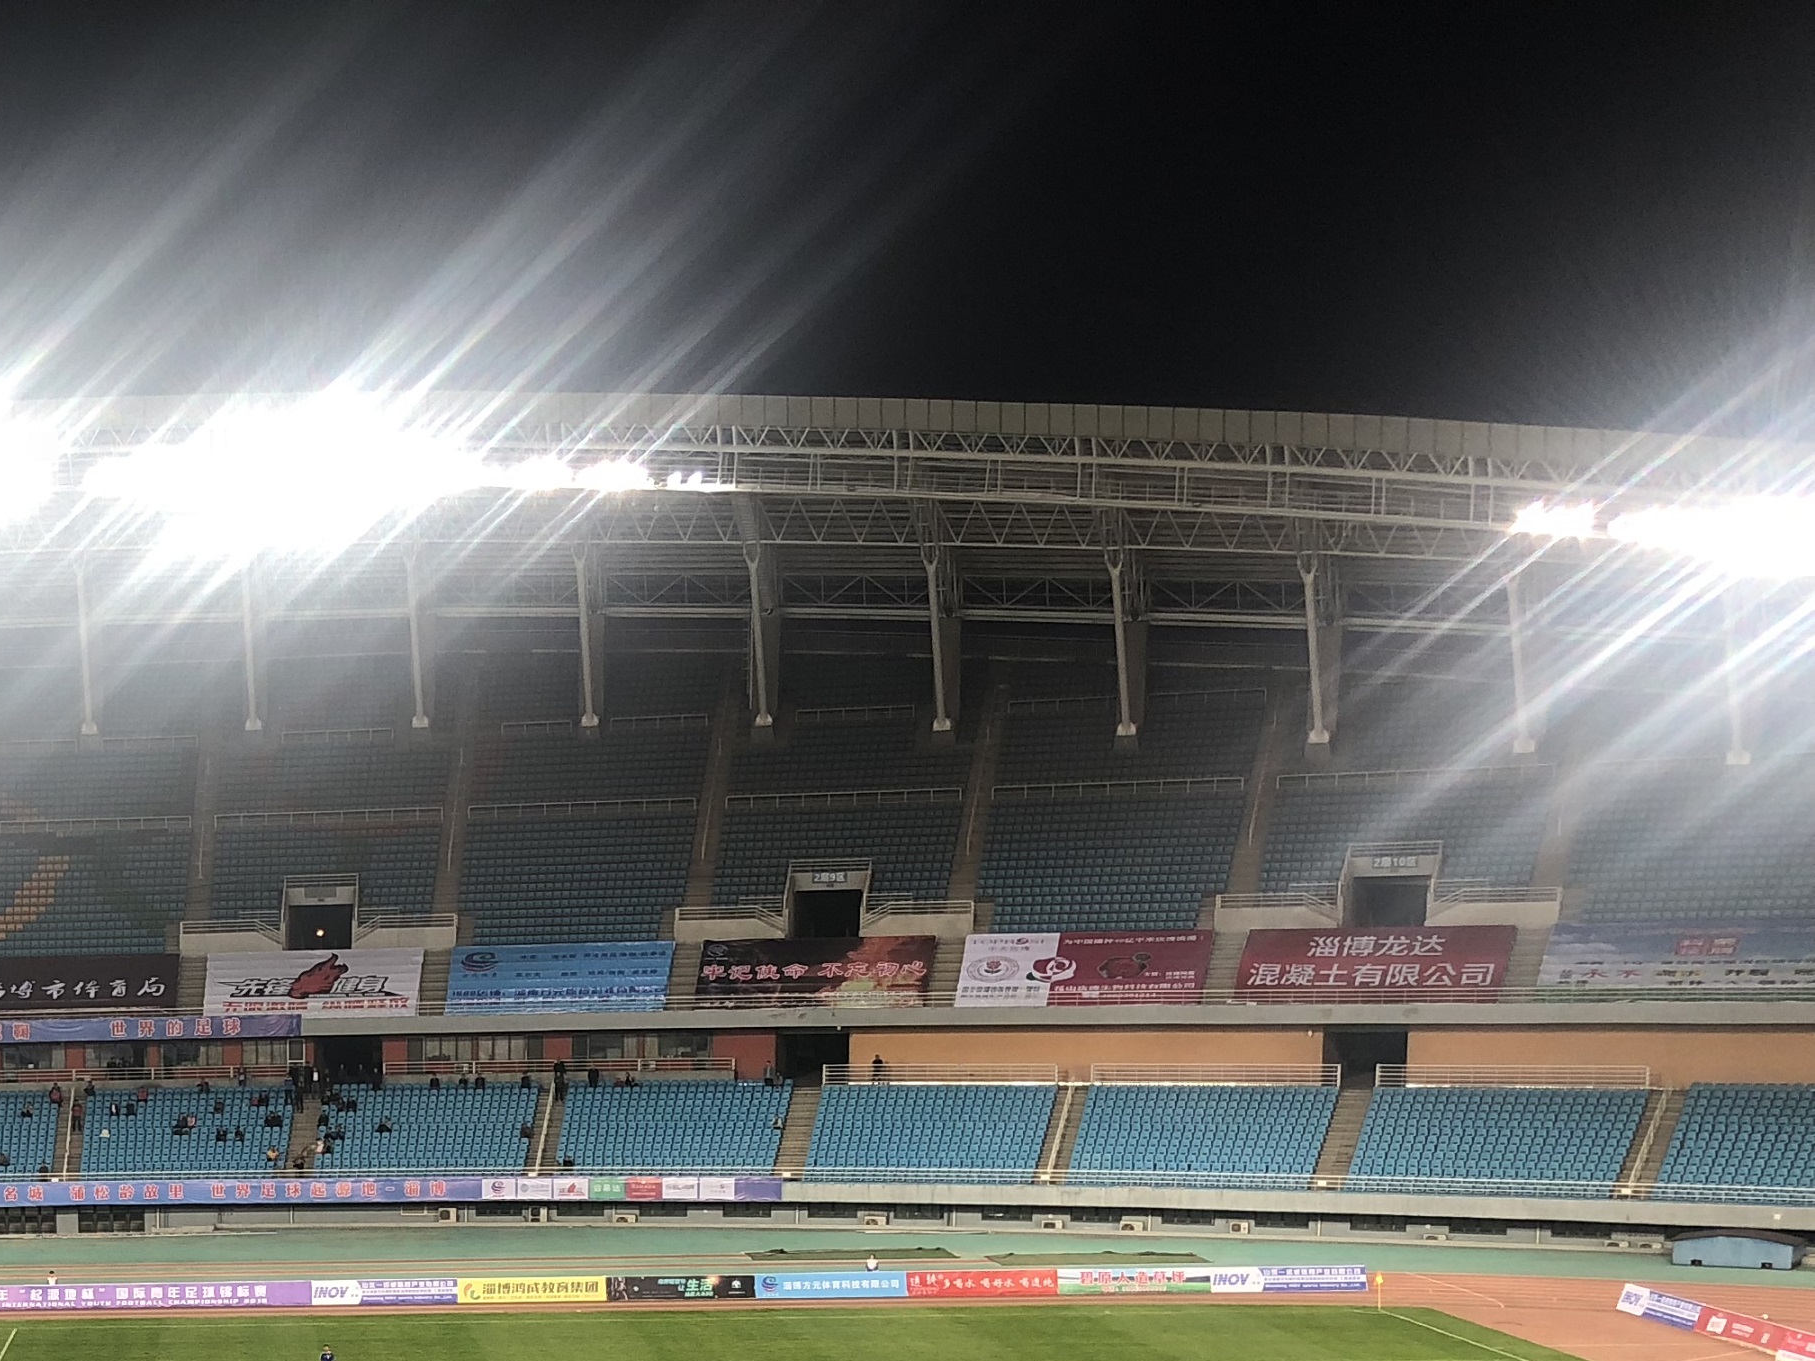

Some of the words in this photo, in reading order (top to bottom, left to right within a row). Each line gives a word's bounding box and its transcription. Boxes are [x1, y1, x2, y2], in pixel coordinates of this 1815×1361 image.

[1306, 934, 1447, 958] 淄博龙达
[701, 962, 809, 980] 牢记使命
[817, 960, 927, 978] 不忘初心
[1246, 962, 1496, 987] 混凝土有限公司
[109, 1018, 242, 1038] 世界的足球
[68, 1182, 185, 1200] 蒲松龄故里
[783, 1279, 900, 1291] 淄博方元体育科技有限公司
[1212, 1273, 1251, 1286] INOV
[115, 1285, 268, 1300] 国际青年足球锦标赛
[313, 1286, 350, 1299] INOV
[482, 1281, 599, 1295] 淄博鸿成教育集团
